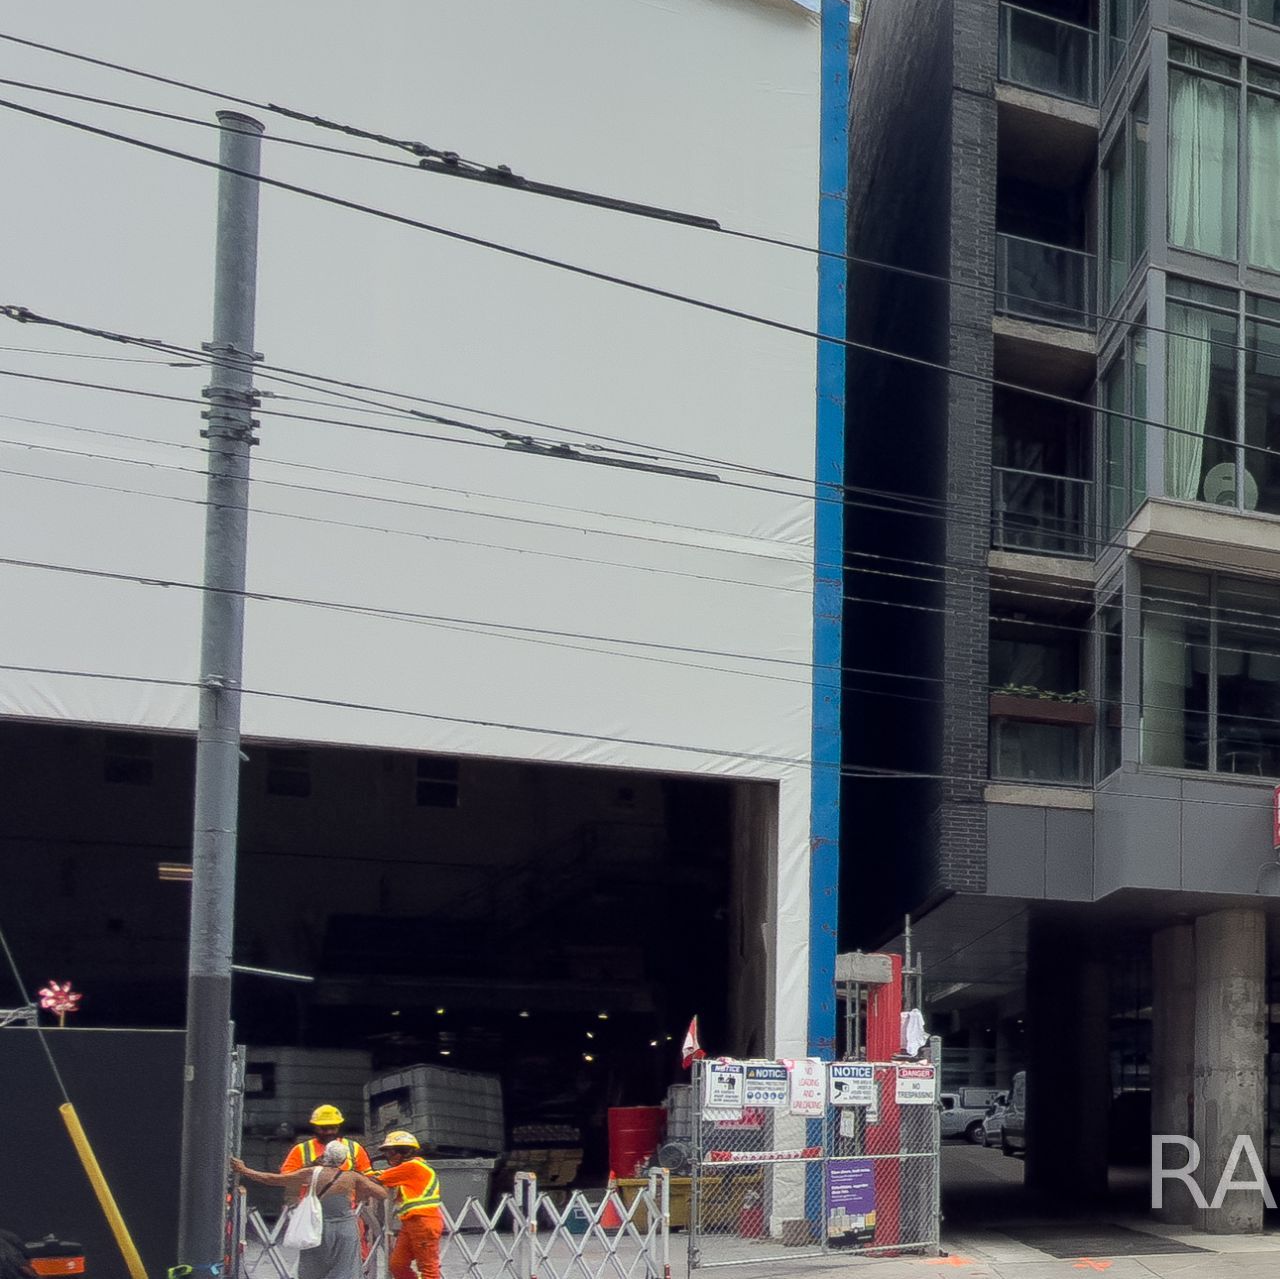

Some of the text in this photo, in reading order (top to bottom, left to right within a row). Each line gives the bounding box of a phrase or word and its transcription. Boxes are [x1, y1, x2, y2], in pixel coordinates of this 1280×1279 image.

[756, 1069, 786, 1078] NOTICE
[833, 1067, 871, 1077] NOTICE
[902, 1069, 931, 1077] DANGER
